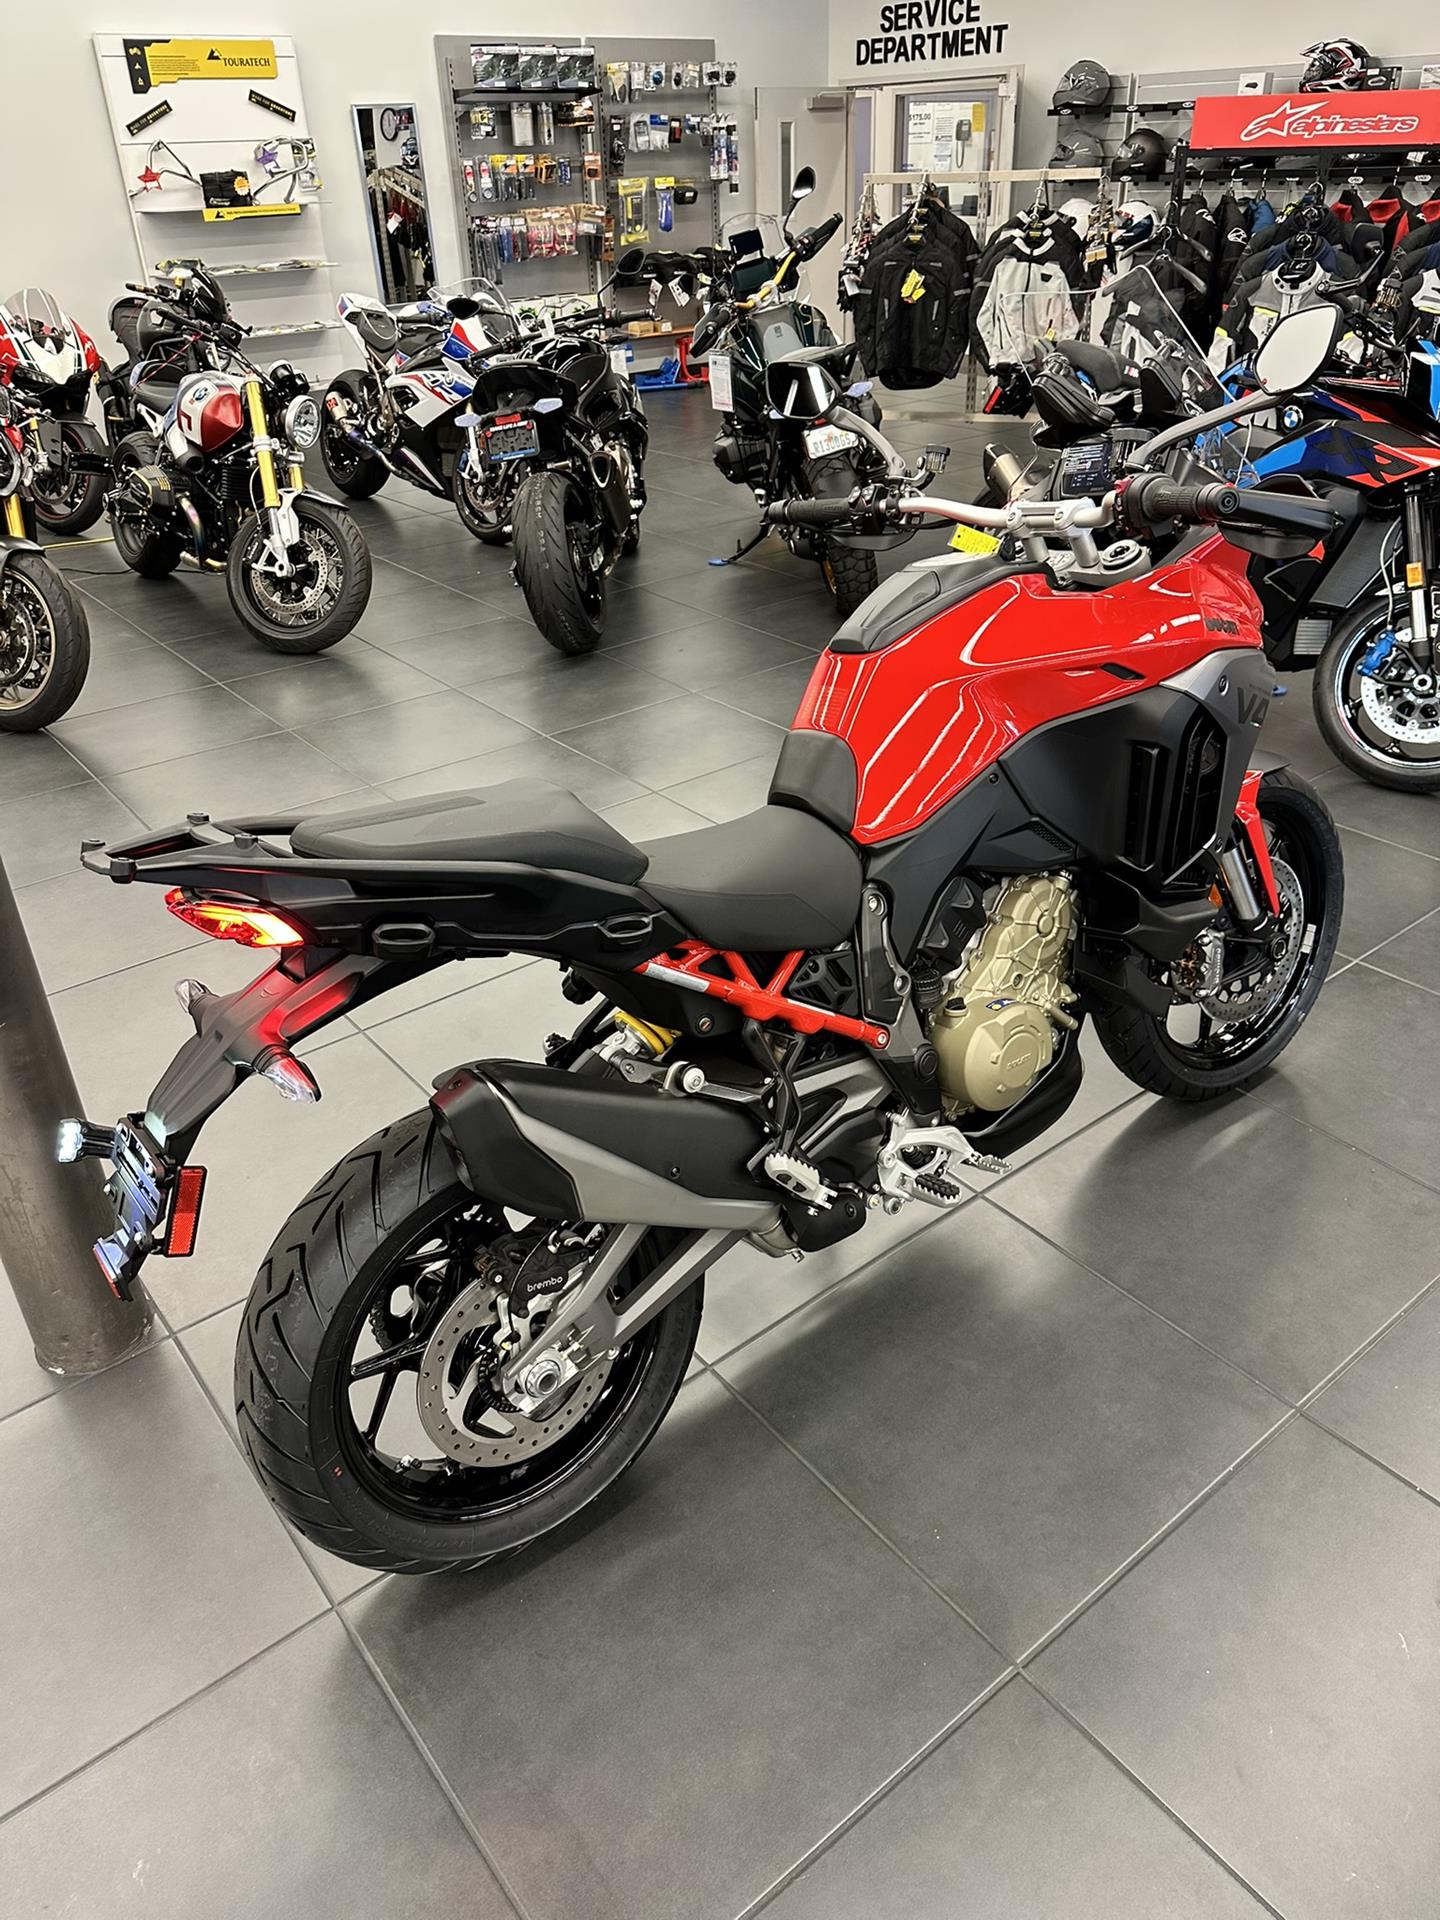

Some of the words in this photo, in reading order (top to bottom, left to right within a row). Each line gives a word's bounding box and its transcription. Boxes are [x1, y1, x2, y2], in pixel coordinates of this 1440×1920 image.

[880, 0, 980, 33] SERVICE
[856, 24, 1009, 66] DEPARTMENT
[223, 57, 271, 68] TOURATECH
[1290, 114, 1419, 139] alpinestars
[1237, 687, 1270, 725] V4
[527, 1276, 563, 1292] brembo
